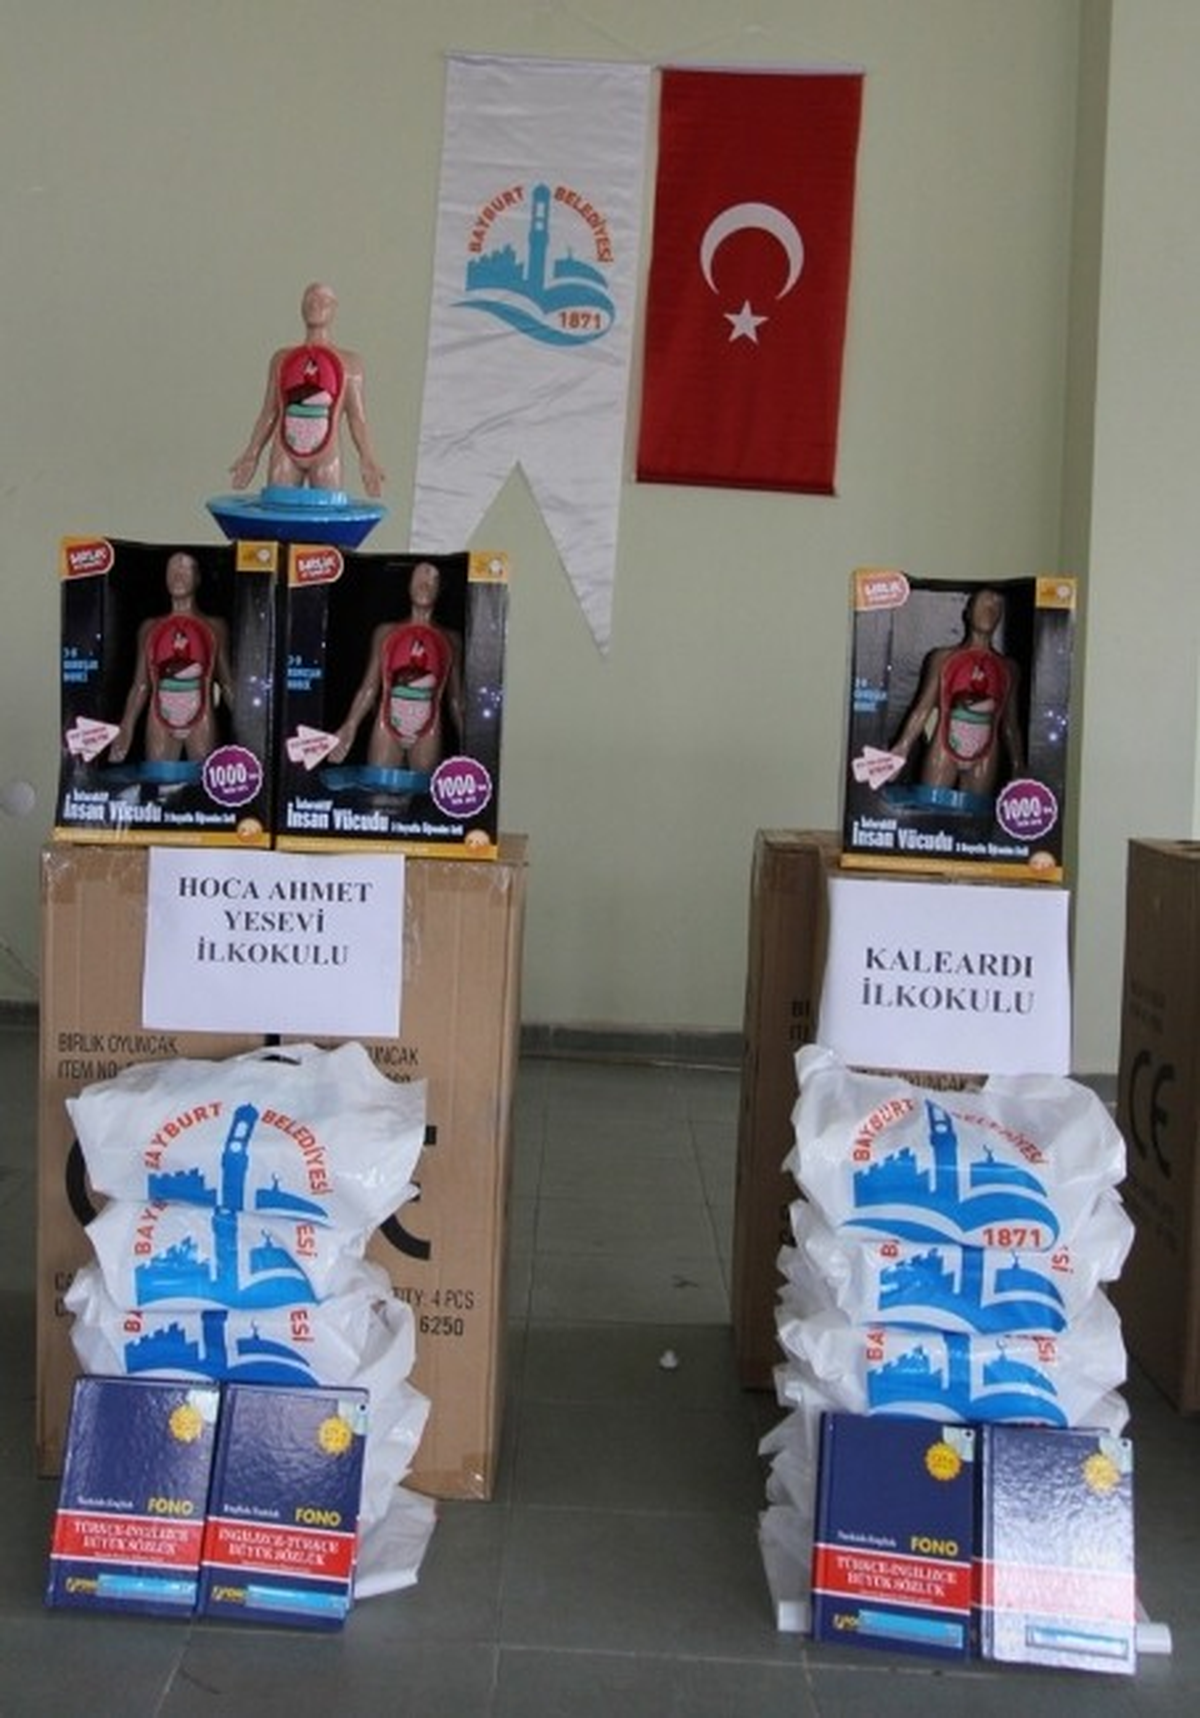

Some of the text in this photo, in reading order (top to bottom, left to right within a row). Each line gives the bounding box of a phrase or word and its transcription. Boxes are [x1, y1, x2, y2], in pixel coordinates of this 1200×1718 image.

[468, 186, 614, 263] BAYBURT BELEDİYESİ
[558, 310, 602, 329] 1871
[209, 763, 247, 788] 1000
[437, 774, 475, 799] 1000
[287, 802, 329, 829] İnsan
[1003, 797, 1041, 820] 1000
[852, 820, 894, 848] İnsan
[179, 876, 374, 903] HOCA AHMET
[224, 908, 325, 933] YESEVİ
[197, 936, 349, 966] İLKOKULU
[865, 947, 1033, 978] KALEARDI
[862, 977, 1034, 1014] İLKOKULU
[57, 1033, 178, 1055] BIRLIK OYUNCAK
[57, 1060, 93, 1079] ITEM
[853, 1098, 914, 1162] BAYBURT
[261, 1109, 333, 1195] BELEDİYESİ
[983, 1228, 1041, 1247] 1871
[445, 1289, 475, 1310] PCS
[420, 1315, 464, 1337] 6250
[148, 1498, 193, 1515] FONO
[295, 1508, 341, 1526] FONO
[910, 1535, 959, 1557] FONO
